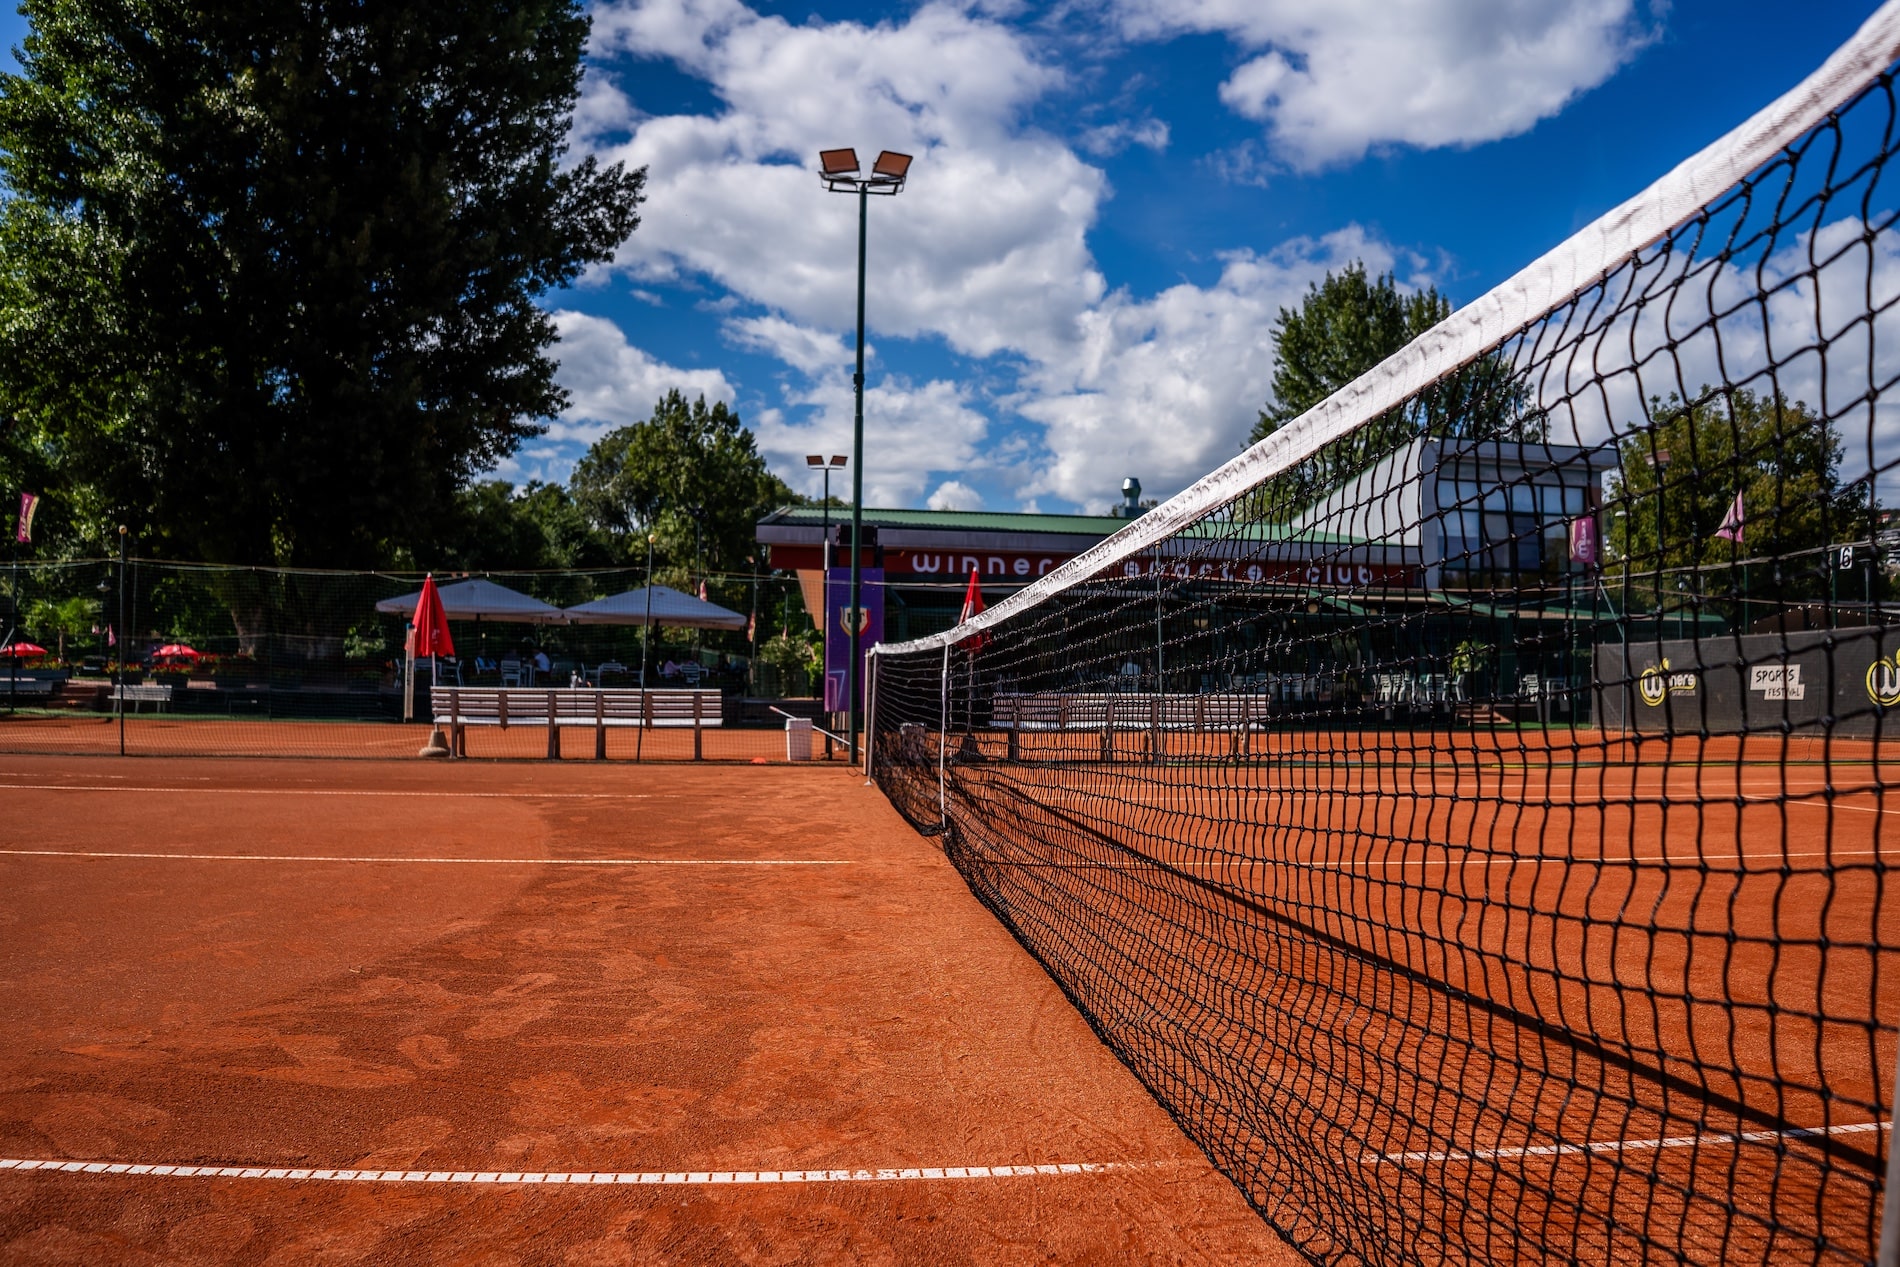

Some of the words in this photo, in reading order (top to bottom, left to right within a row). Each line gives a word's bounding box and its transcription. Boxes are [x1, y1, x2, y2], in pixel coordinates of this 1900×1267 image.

[1842, 547, 1851, 567] 6
[1306, 564, 1374, 584] club
[1768, 687, 1801, 697] FESTVAL
